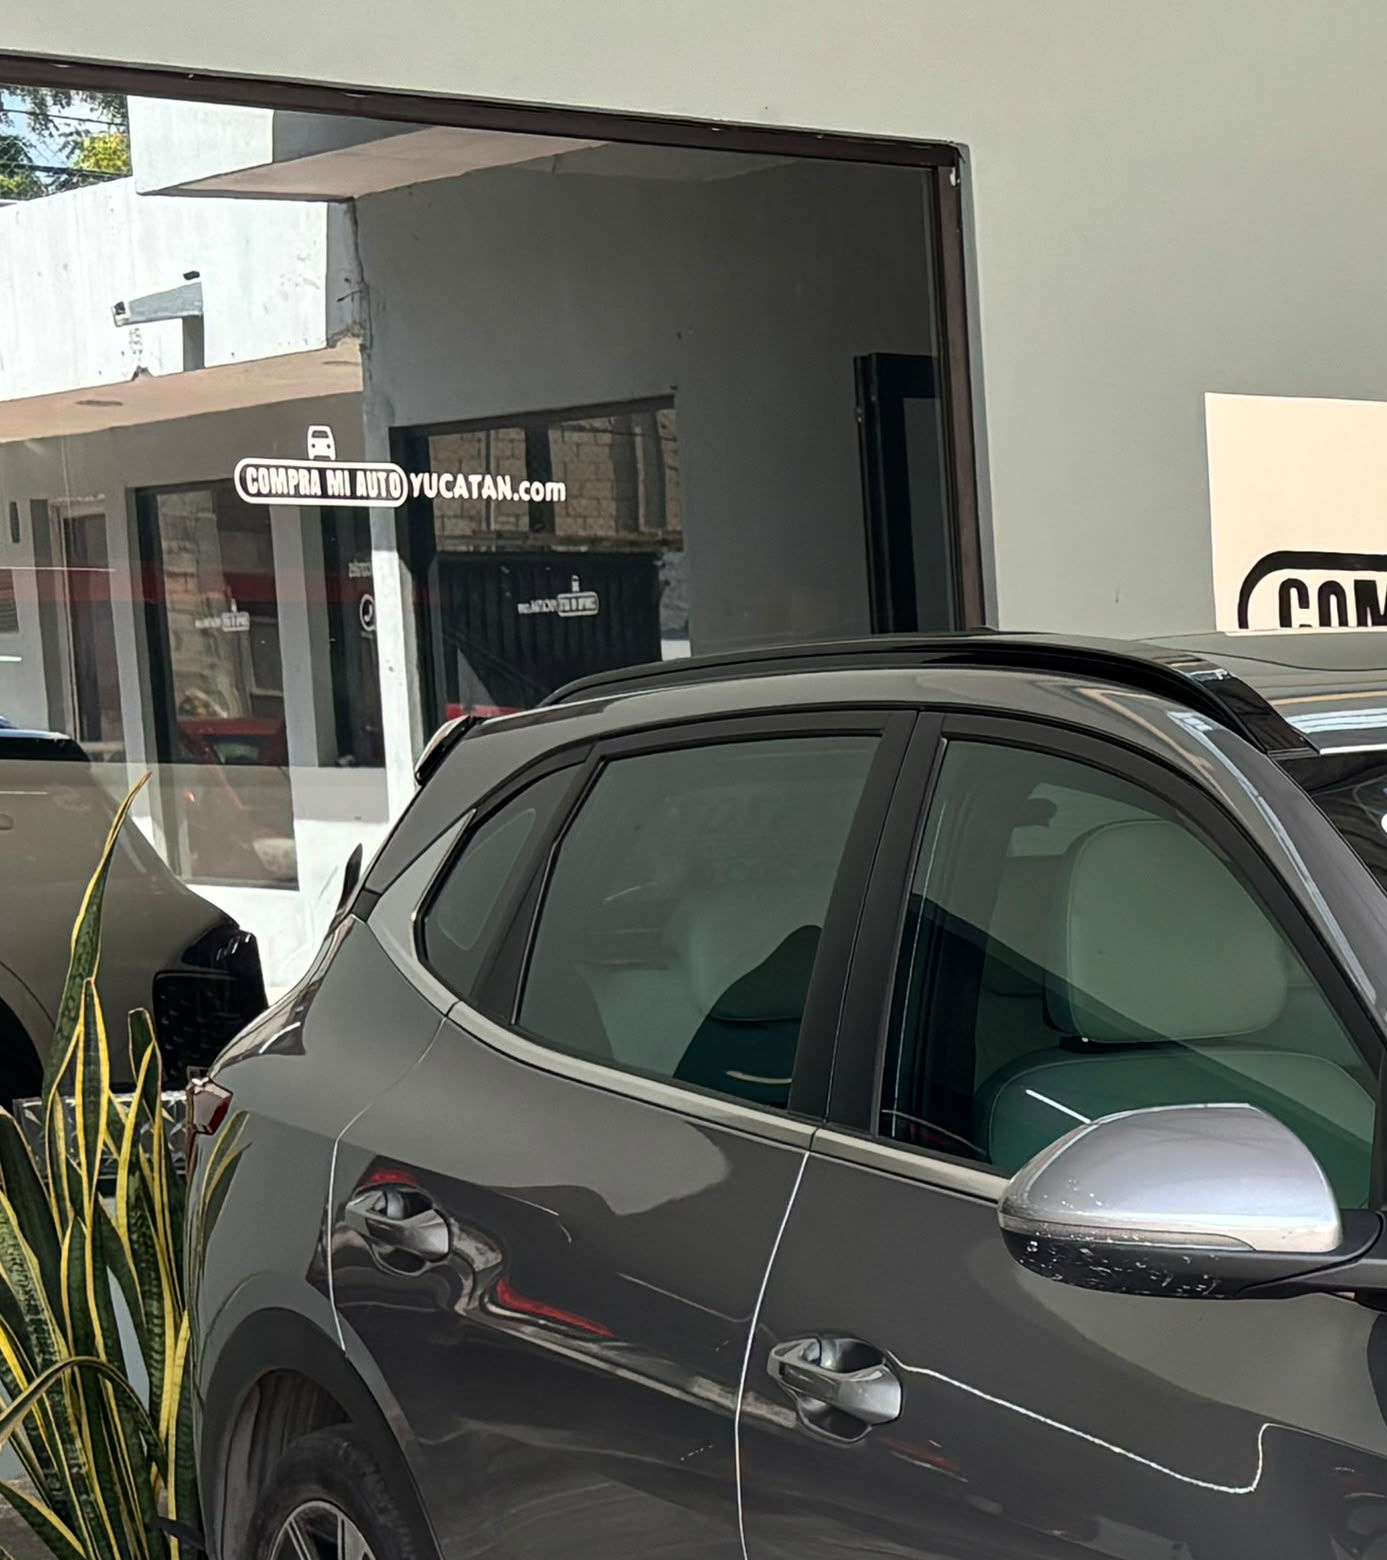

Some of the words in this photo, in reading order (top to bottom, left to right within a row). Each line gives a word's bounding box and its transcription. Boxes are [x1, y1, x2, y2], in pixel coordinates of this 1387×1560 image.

[246, 466, 322, 497] COMPRA
[326, 468, 351, 496] MI
[356, 470, 401, 499] AUTO
[409, 473, 567, 502] YUCATAN.com
